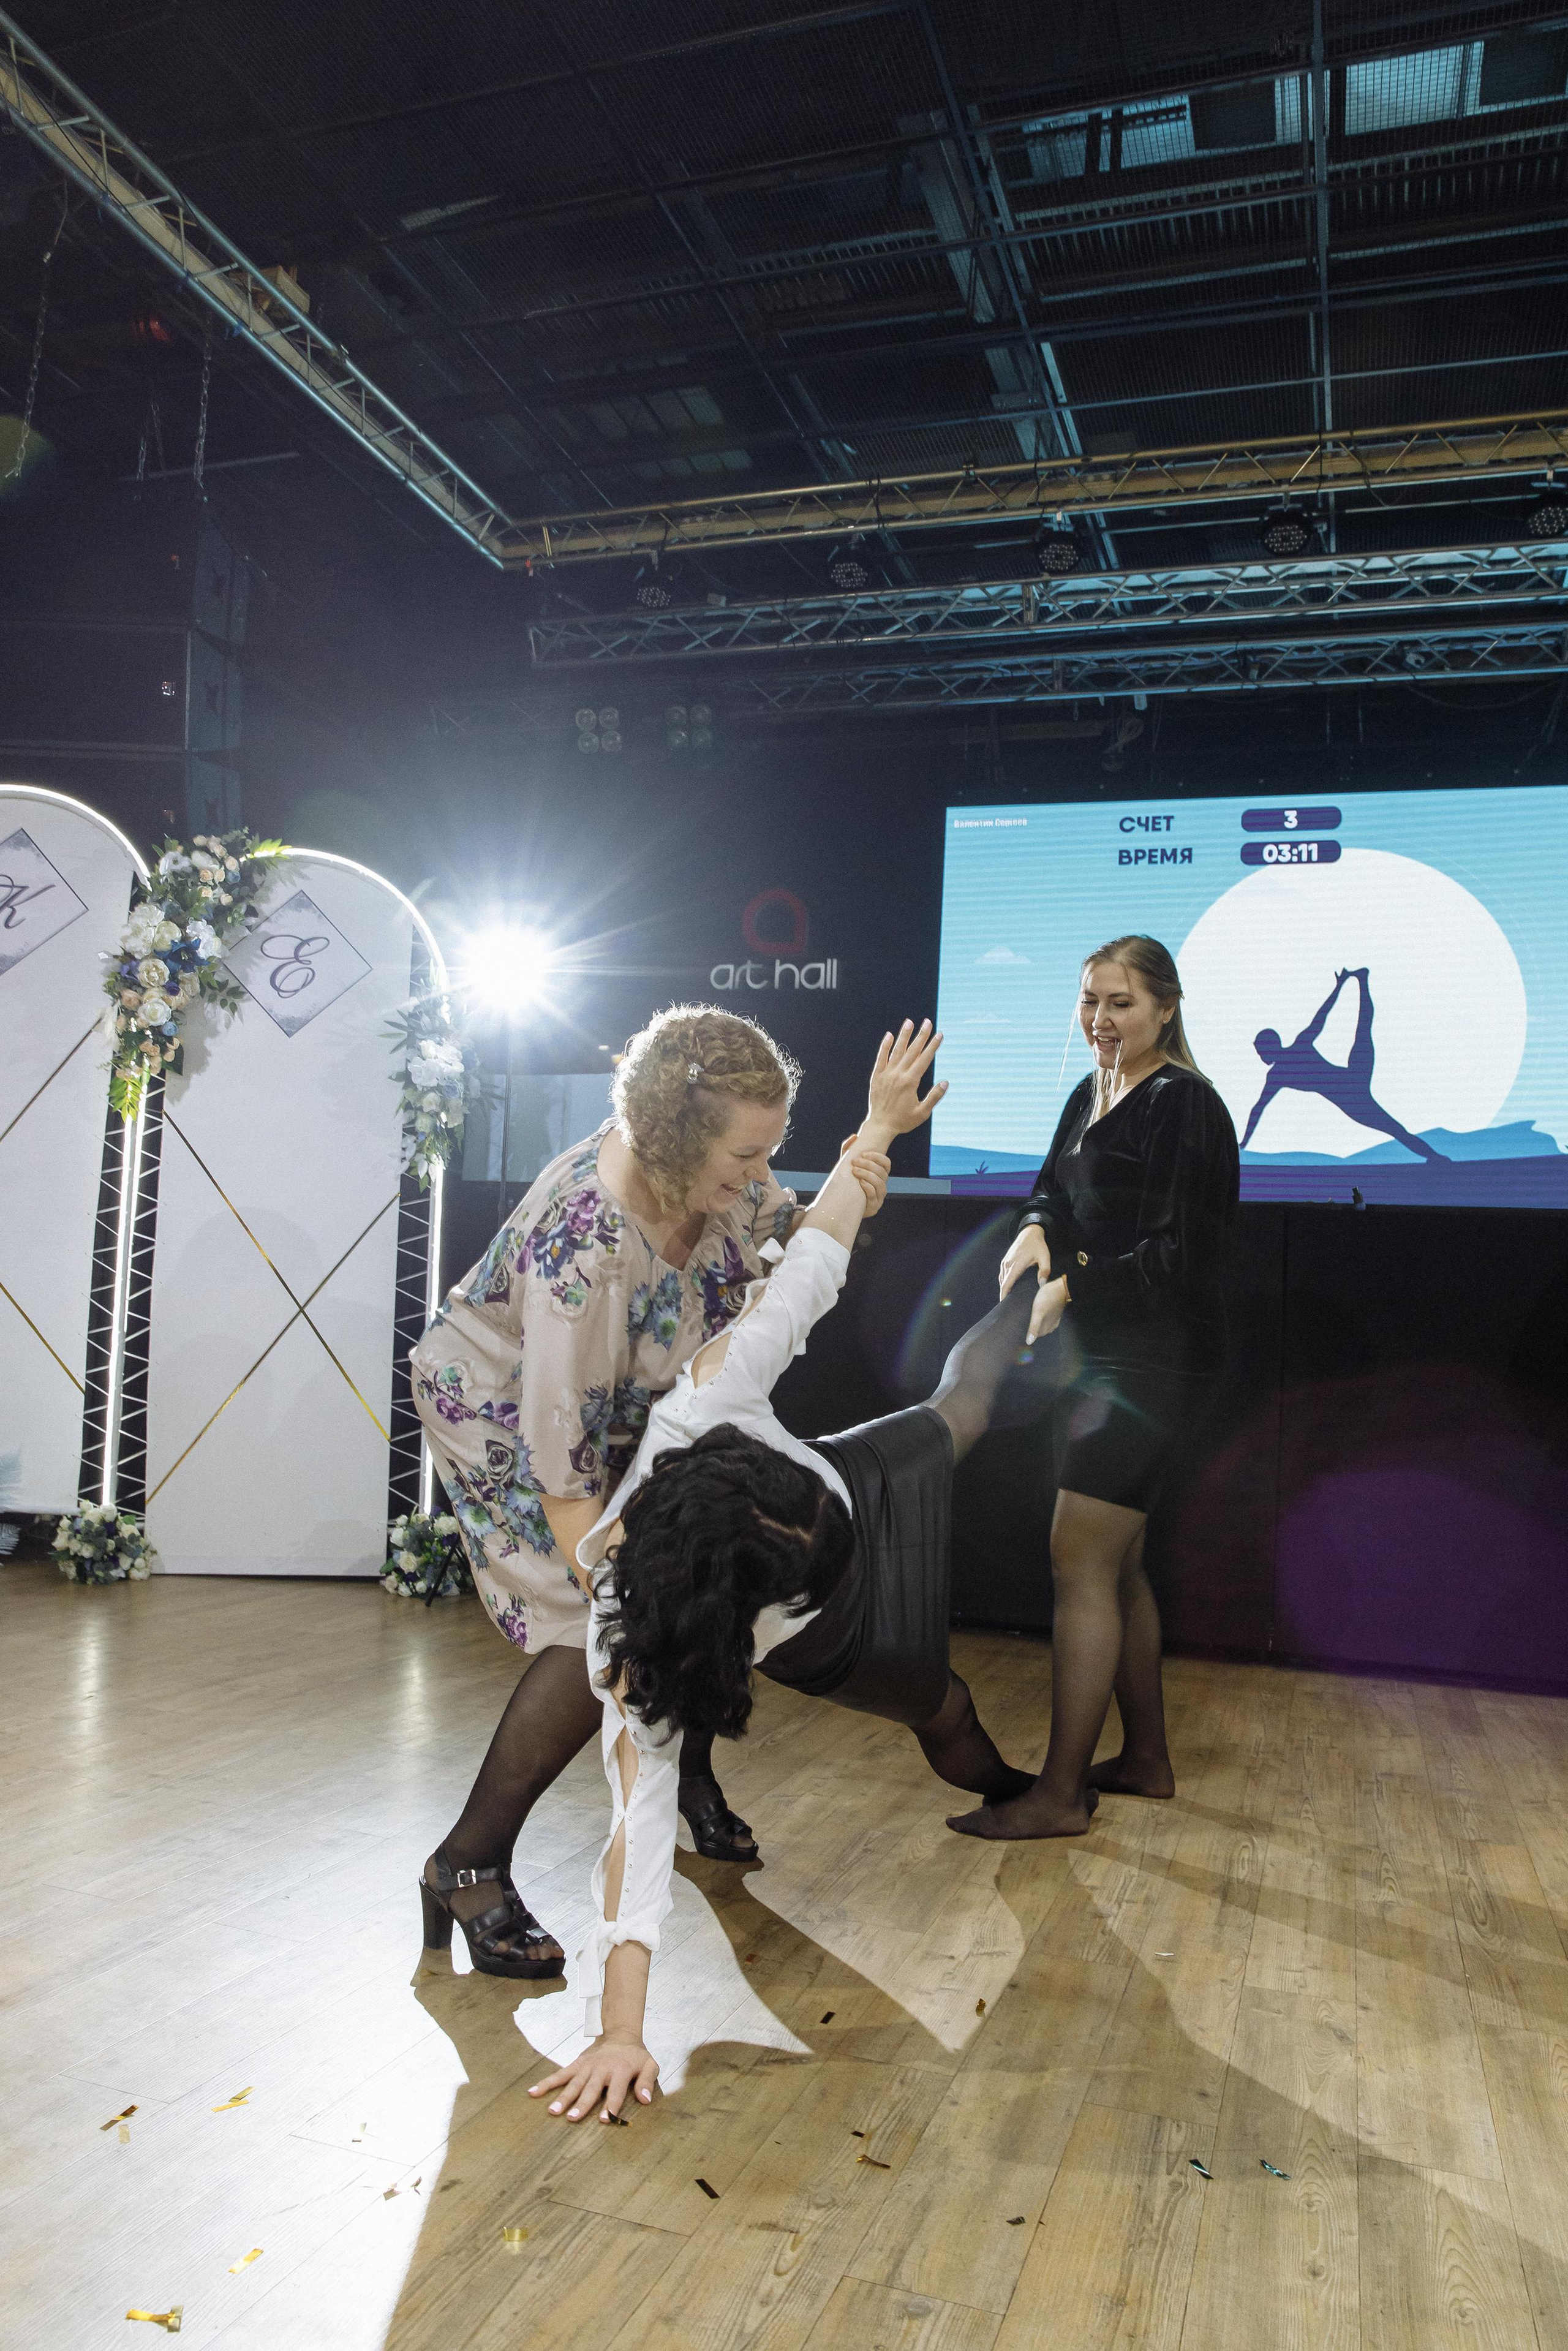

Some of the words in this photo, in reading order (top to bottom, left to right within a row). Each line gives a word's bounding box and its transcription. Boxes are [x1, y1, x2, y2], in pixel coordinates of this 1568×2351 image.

[1119, 815, 1175, 832] СЧЕТ
[1283, 810, 1298, 829] 3
[1118, 847, 1193, 866] ВРЕМЯ
[1262, 843, 1319, 863] 03:11
[709, 959, 768, 990] art
[774, 958, 837, 990] hall
